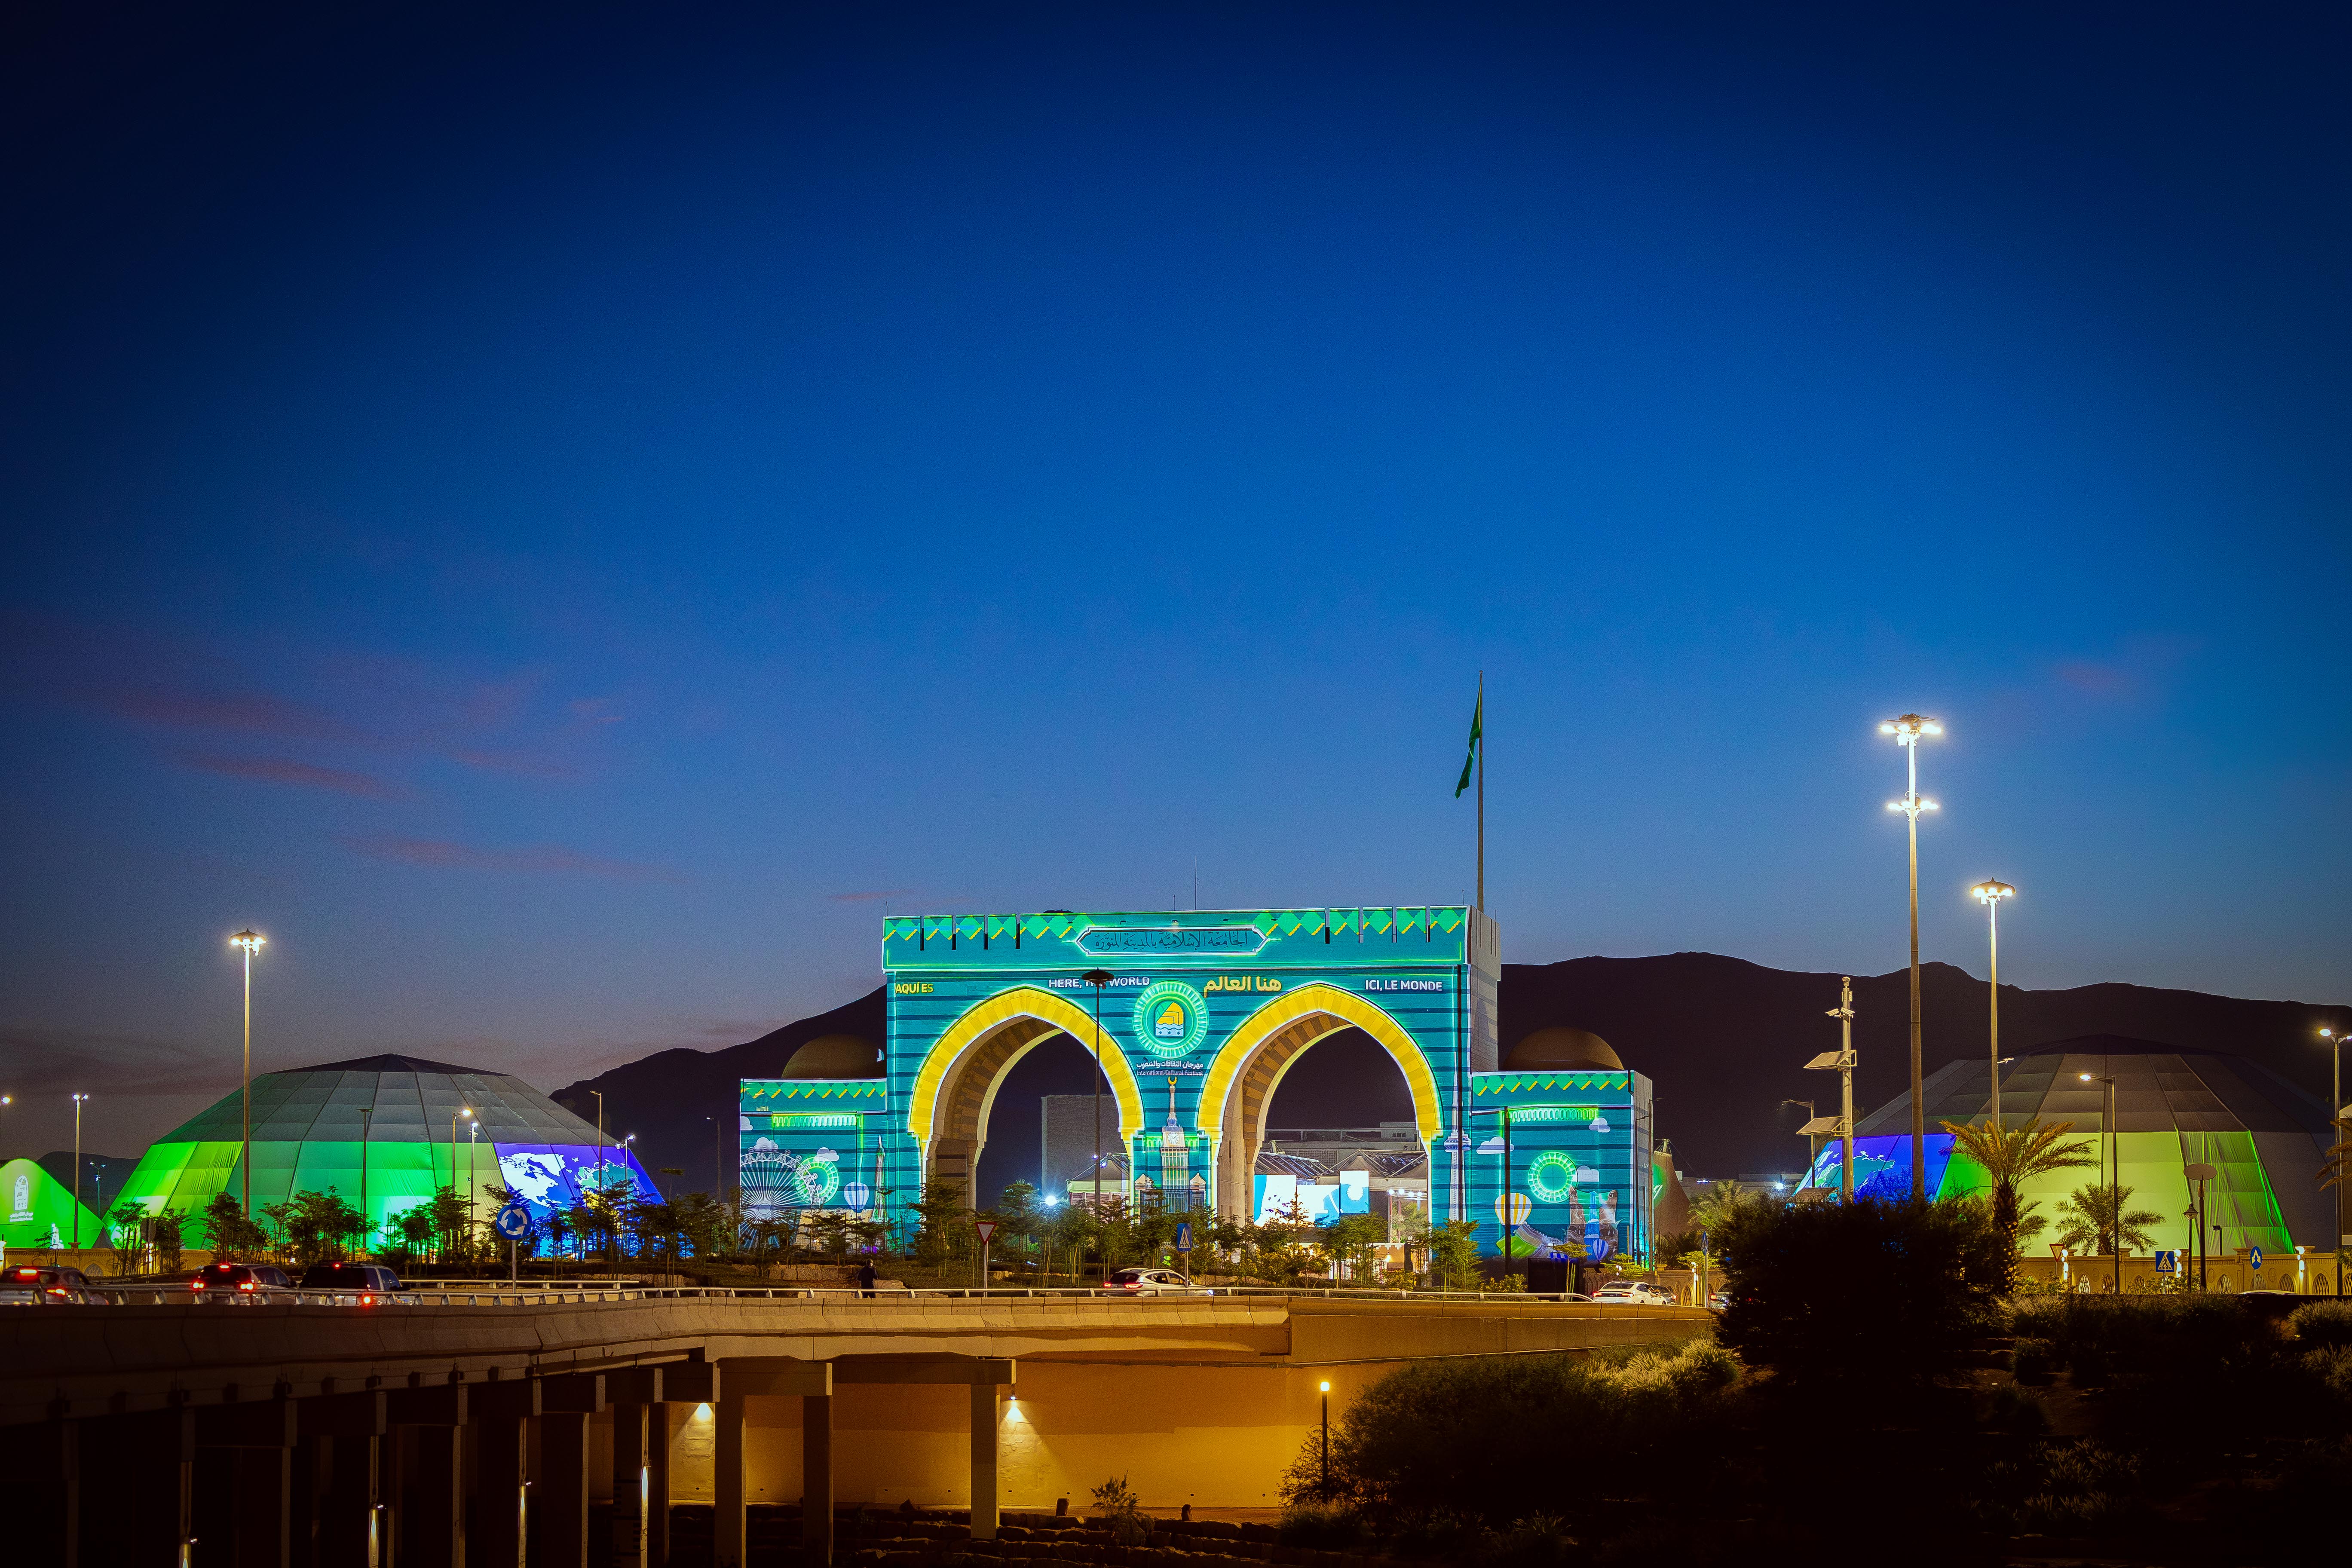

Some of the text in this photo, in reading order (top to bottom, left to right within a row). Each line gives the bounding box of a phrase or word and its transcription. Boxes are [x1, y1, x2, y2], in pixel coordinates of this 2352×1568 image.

[896, 982, 934, 994] AQUÍ ES
[1049, 978, 1082, 988] HERE,
[1109, 977, 1150, 986] WORLD
[1204, 976, 1282, 998] هنا العالم
[1366, 980, 1442, 991] ICI, LE MONDE
[1136, 1060, 1161, 1069] والشعوب
[1182, 1060, 1204, 1069] مهرجان
